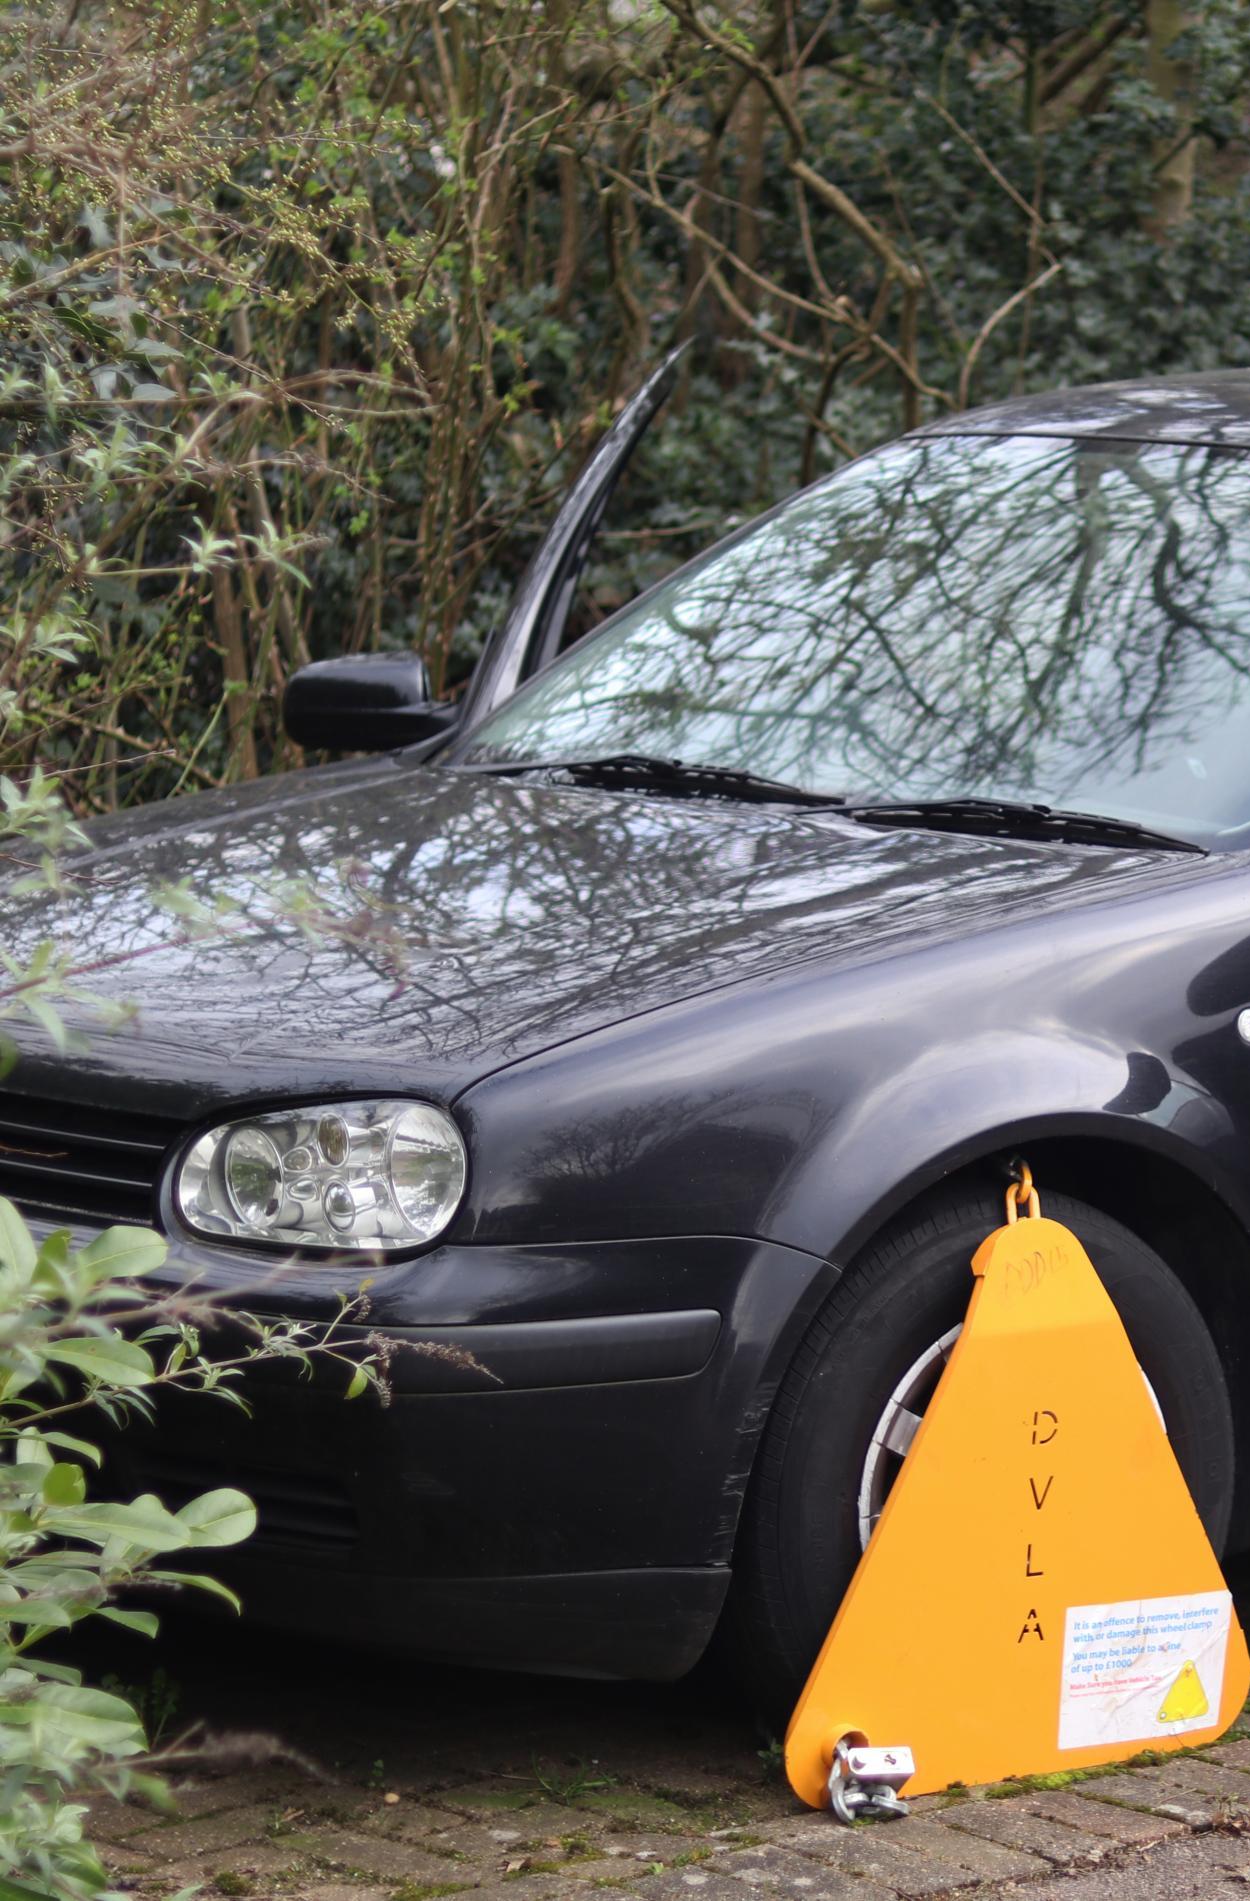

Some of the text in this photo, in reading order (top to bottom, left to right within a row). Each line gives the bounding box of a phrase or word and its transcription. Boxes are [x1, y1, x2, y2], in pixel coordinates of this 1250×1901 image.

[1074, 1622, 1080, 1630] It
[1082, 1621, 1089, 1629] is
[1091, 1622, 1102, 1630] an
[1104, 1617, 1135, 1626] offence
[1183, 1608, 1218, 1619] interfere
[1107, 1629, 1141, 1639] damage
[1143, 1626, 1158, 1635] this
[1073, 1652, 1087, 1661] You
[1089, 1651, 1107, 1660] may
[1109, 1648, 1120, 1656] be
[1122, 1645, 1145, 1655] liable
[1071, 1664, 1080, 1673] of
[1082, 1665, 1093, 1674] up
